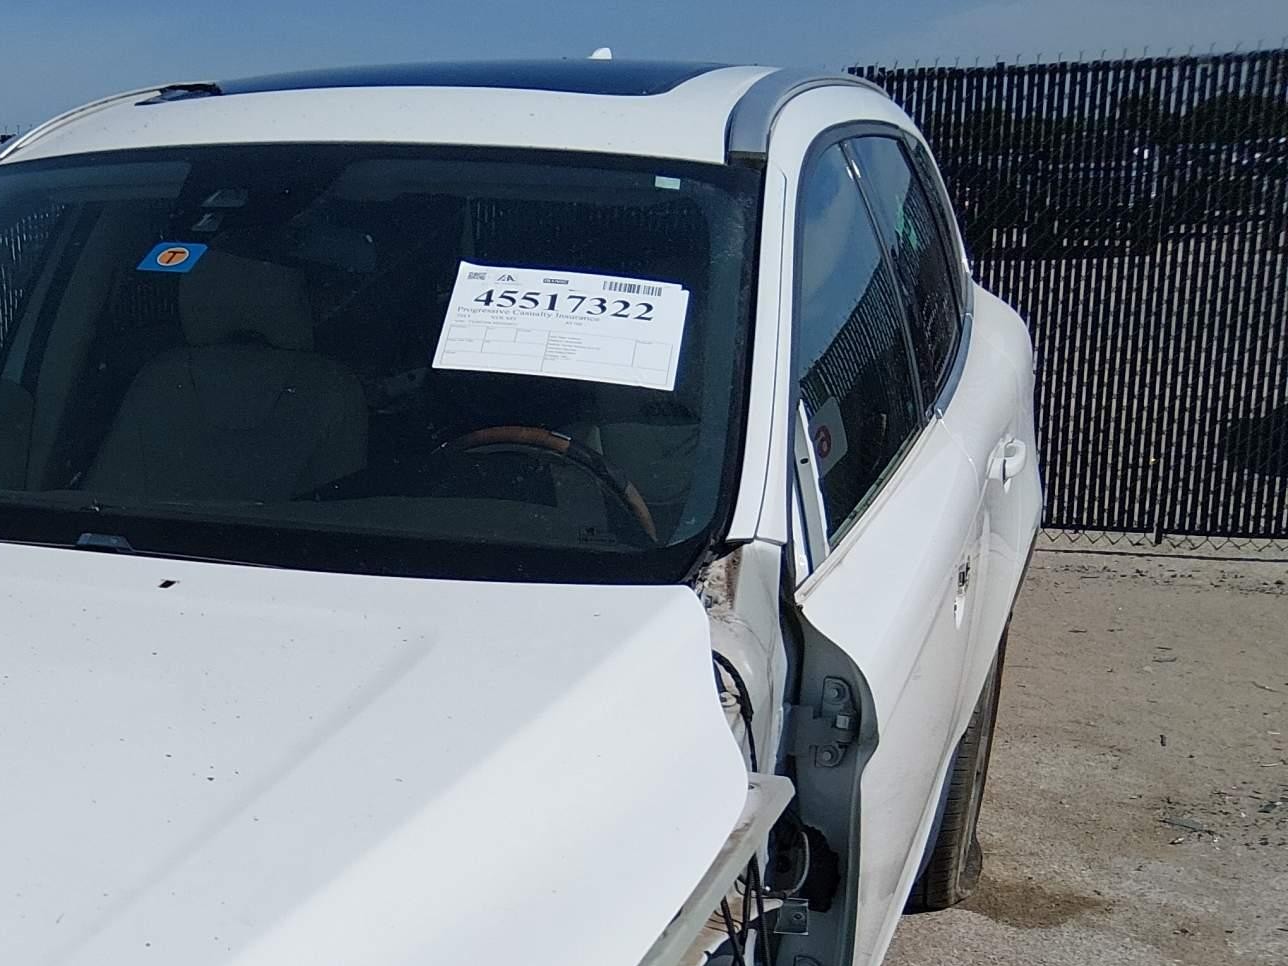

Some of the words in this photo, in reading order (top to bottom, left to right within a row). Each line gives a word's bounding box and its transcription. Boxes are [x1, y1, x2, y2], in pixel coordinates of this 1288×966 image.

[457, 305, 511, 315] Progressive
[512, 309, 553, 319] Casualty
[555, 312, 601, 322] Insurance
[473, 288, 655, 322] 45517322
